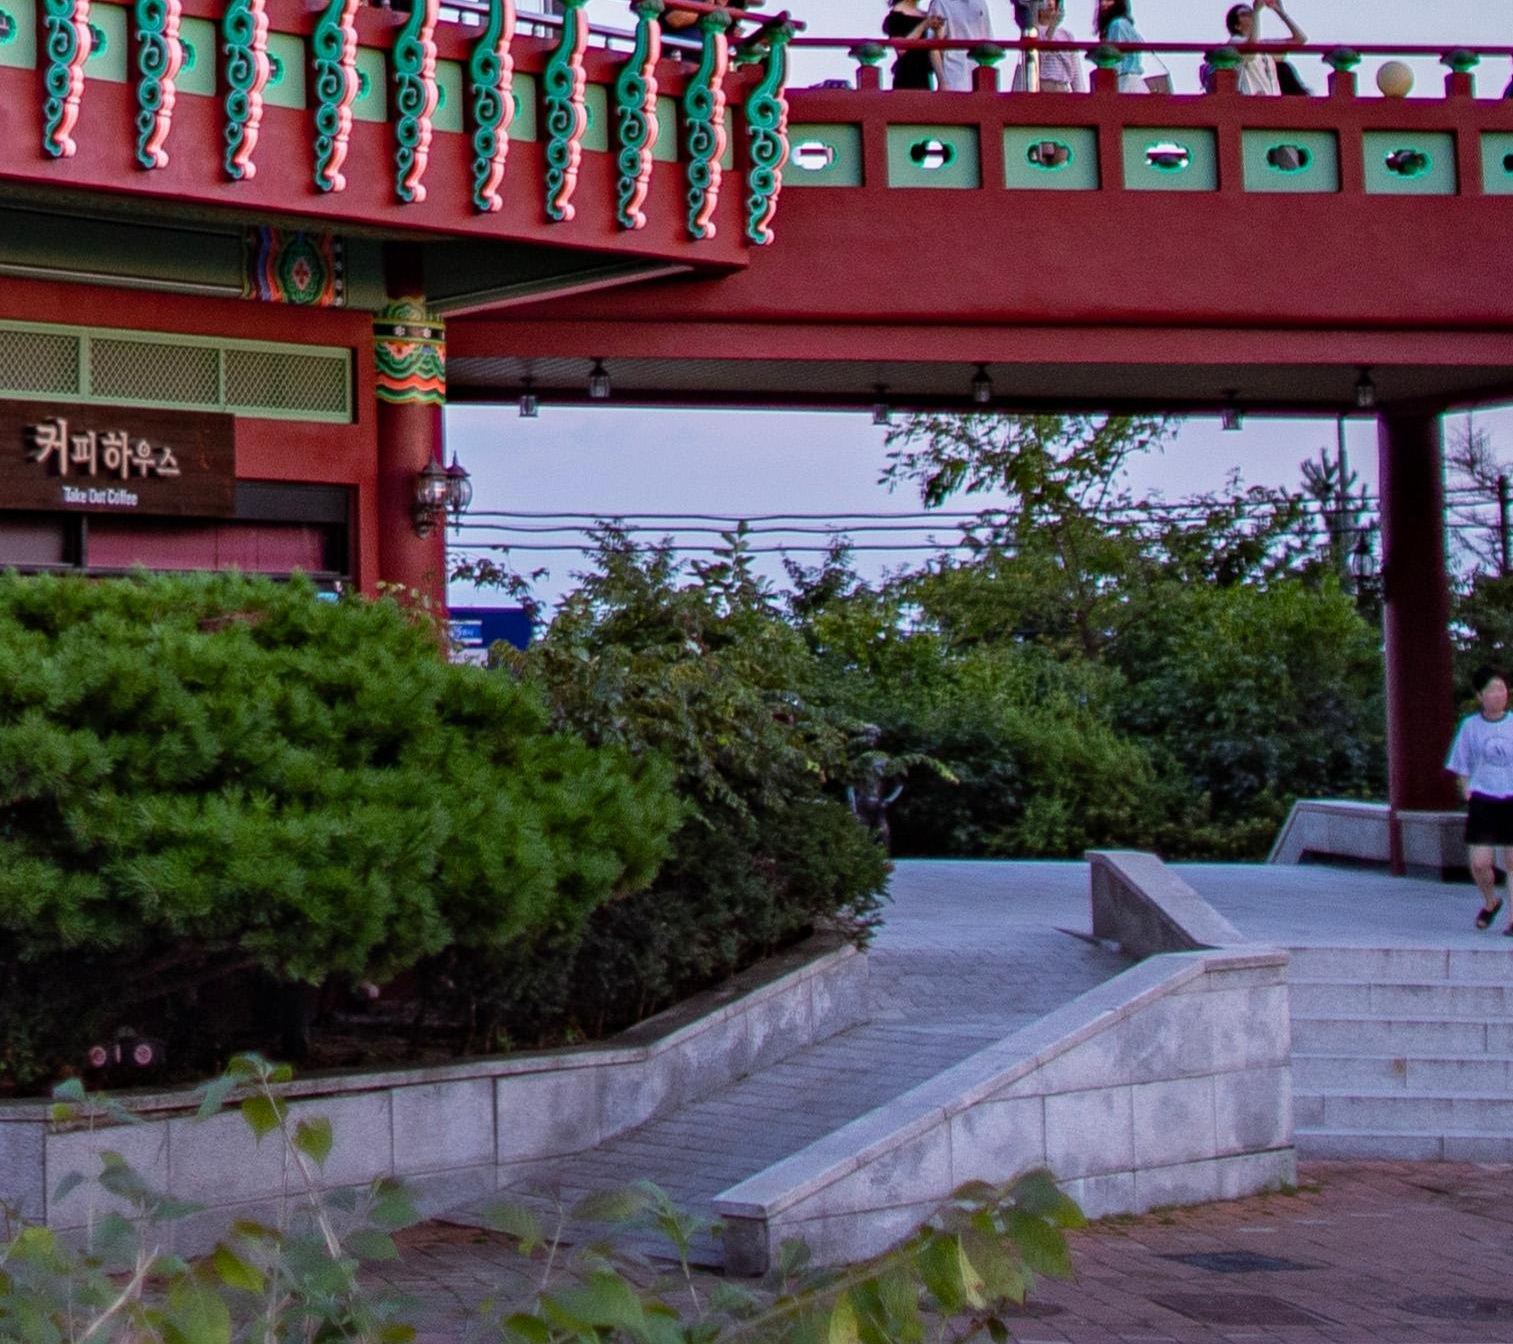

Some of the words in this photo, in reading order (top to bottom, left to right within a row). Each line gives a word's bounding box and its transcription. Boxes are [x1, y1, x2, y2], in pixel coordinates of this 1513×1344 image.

[34, 416, 181, 479] 커피하우스
[62, 485, 87, 503] Take
[89, 488, 106, 504] Out
[107, 488, 138, 506] Coffee
